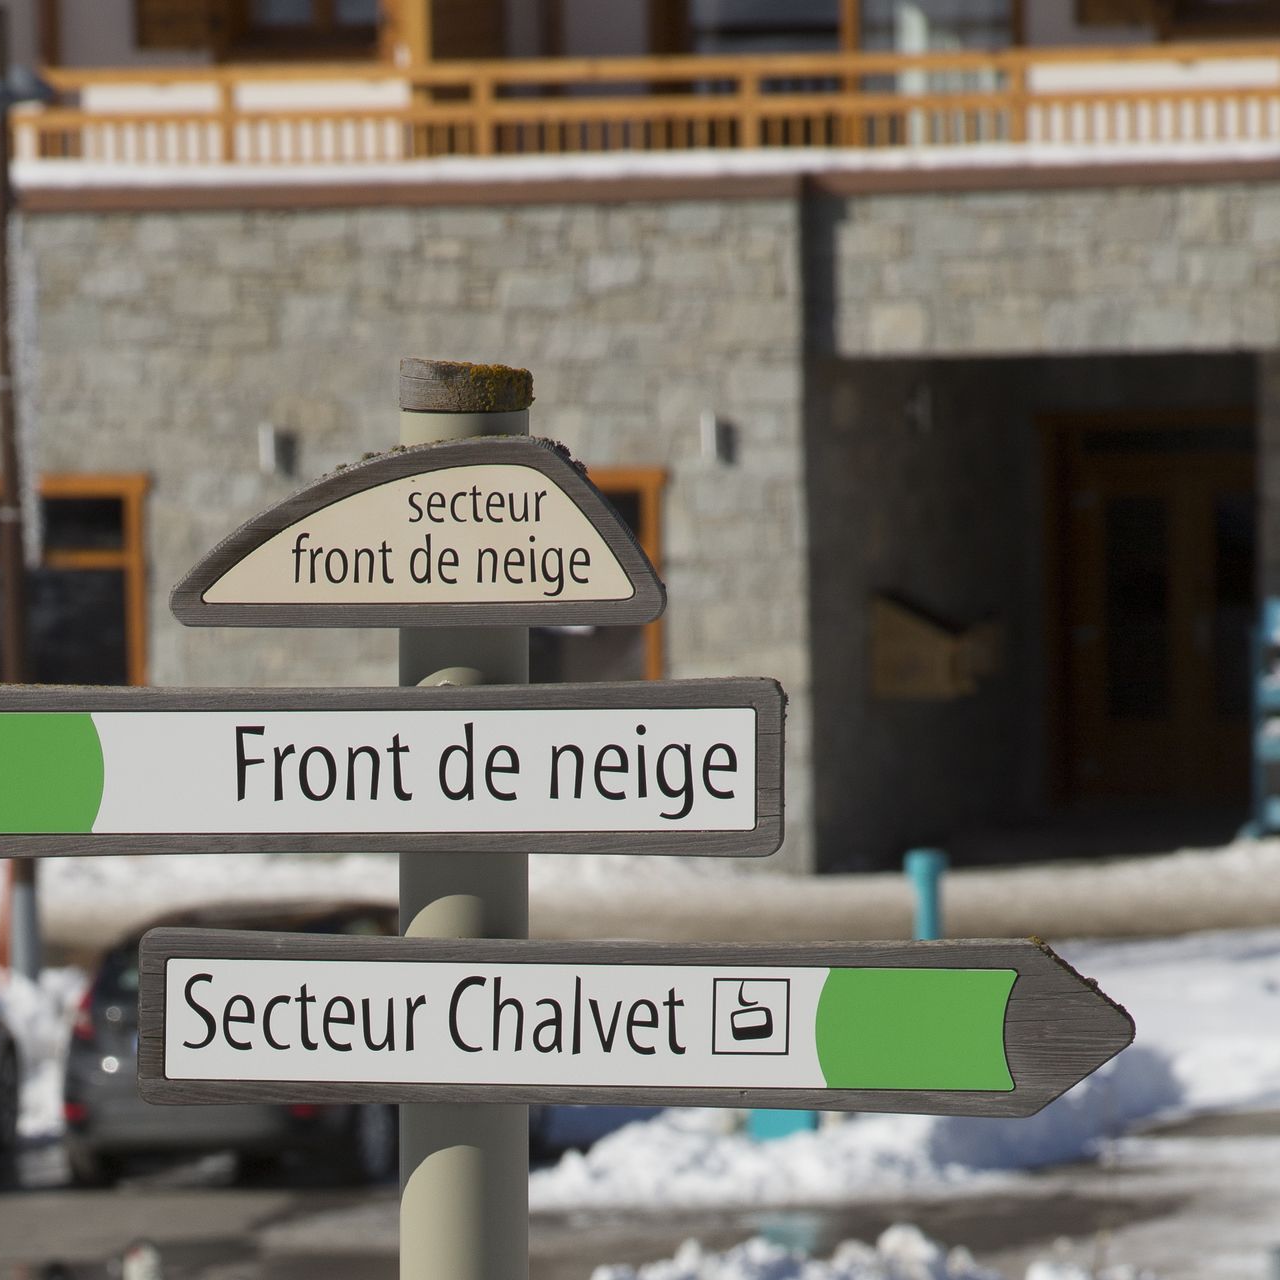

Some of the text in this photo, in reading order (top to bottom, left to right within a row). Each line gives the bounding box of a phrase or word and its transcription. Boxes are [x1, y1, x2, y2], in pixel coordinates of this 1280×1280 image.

[408, 485, 548, 523] secteur
[291, 532, 591, 597] front de neige
[235, 722, 738, 820] Front de neige
[182, 973, 687, 1056] Secteur Chalvet
